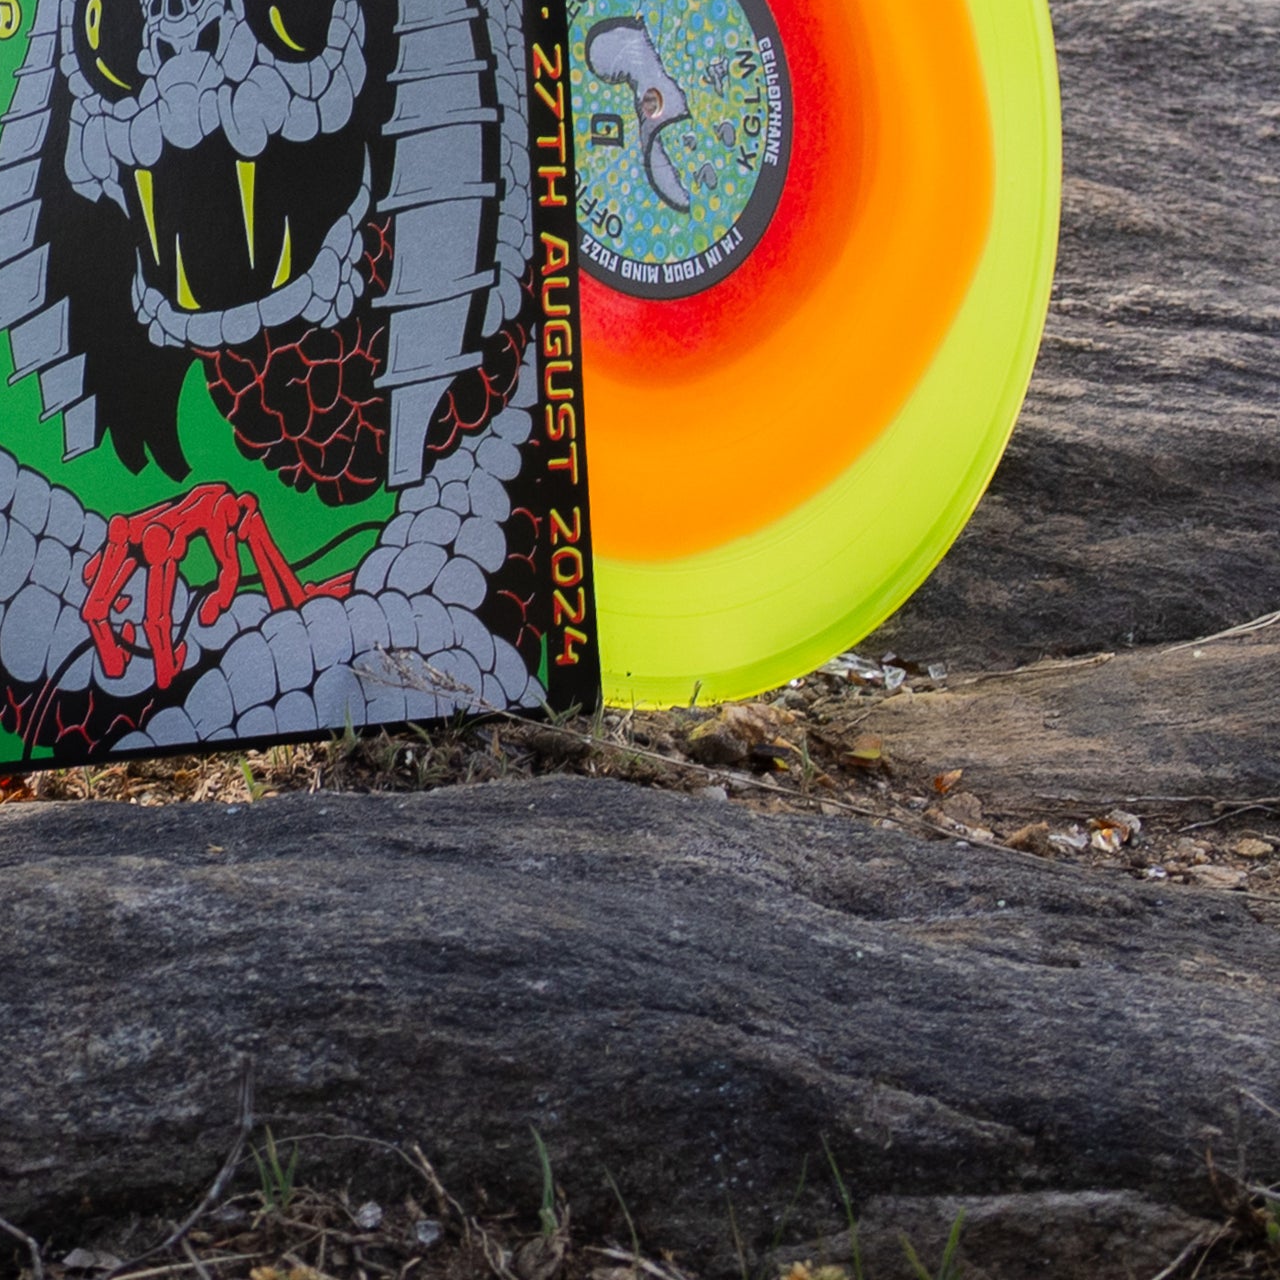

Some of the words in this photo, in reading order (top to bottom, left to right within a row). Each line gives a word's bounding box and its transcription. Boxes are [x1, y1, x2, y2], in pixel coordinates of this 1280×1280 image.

[531, 41, 568, 208] 27TH
[540, 231, 579, 487] AUGUST
[547, 508, 587, 666] 2024
